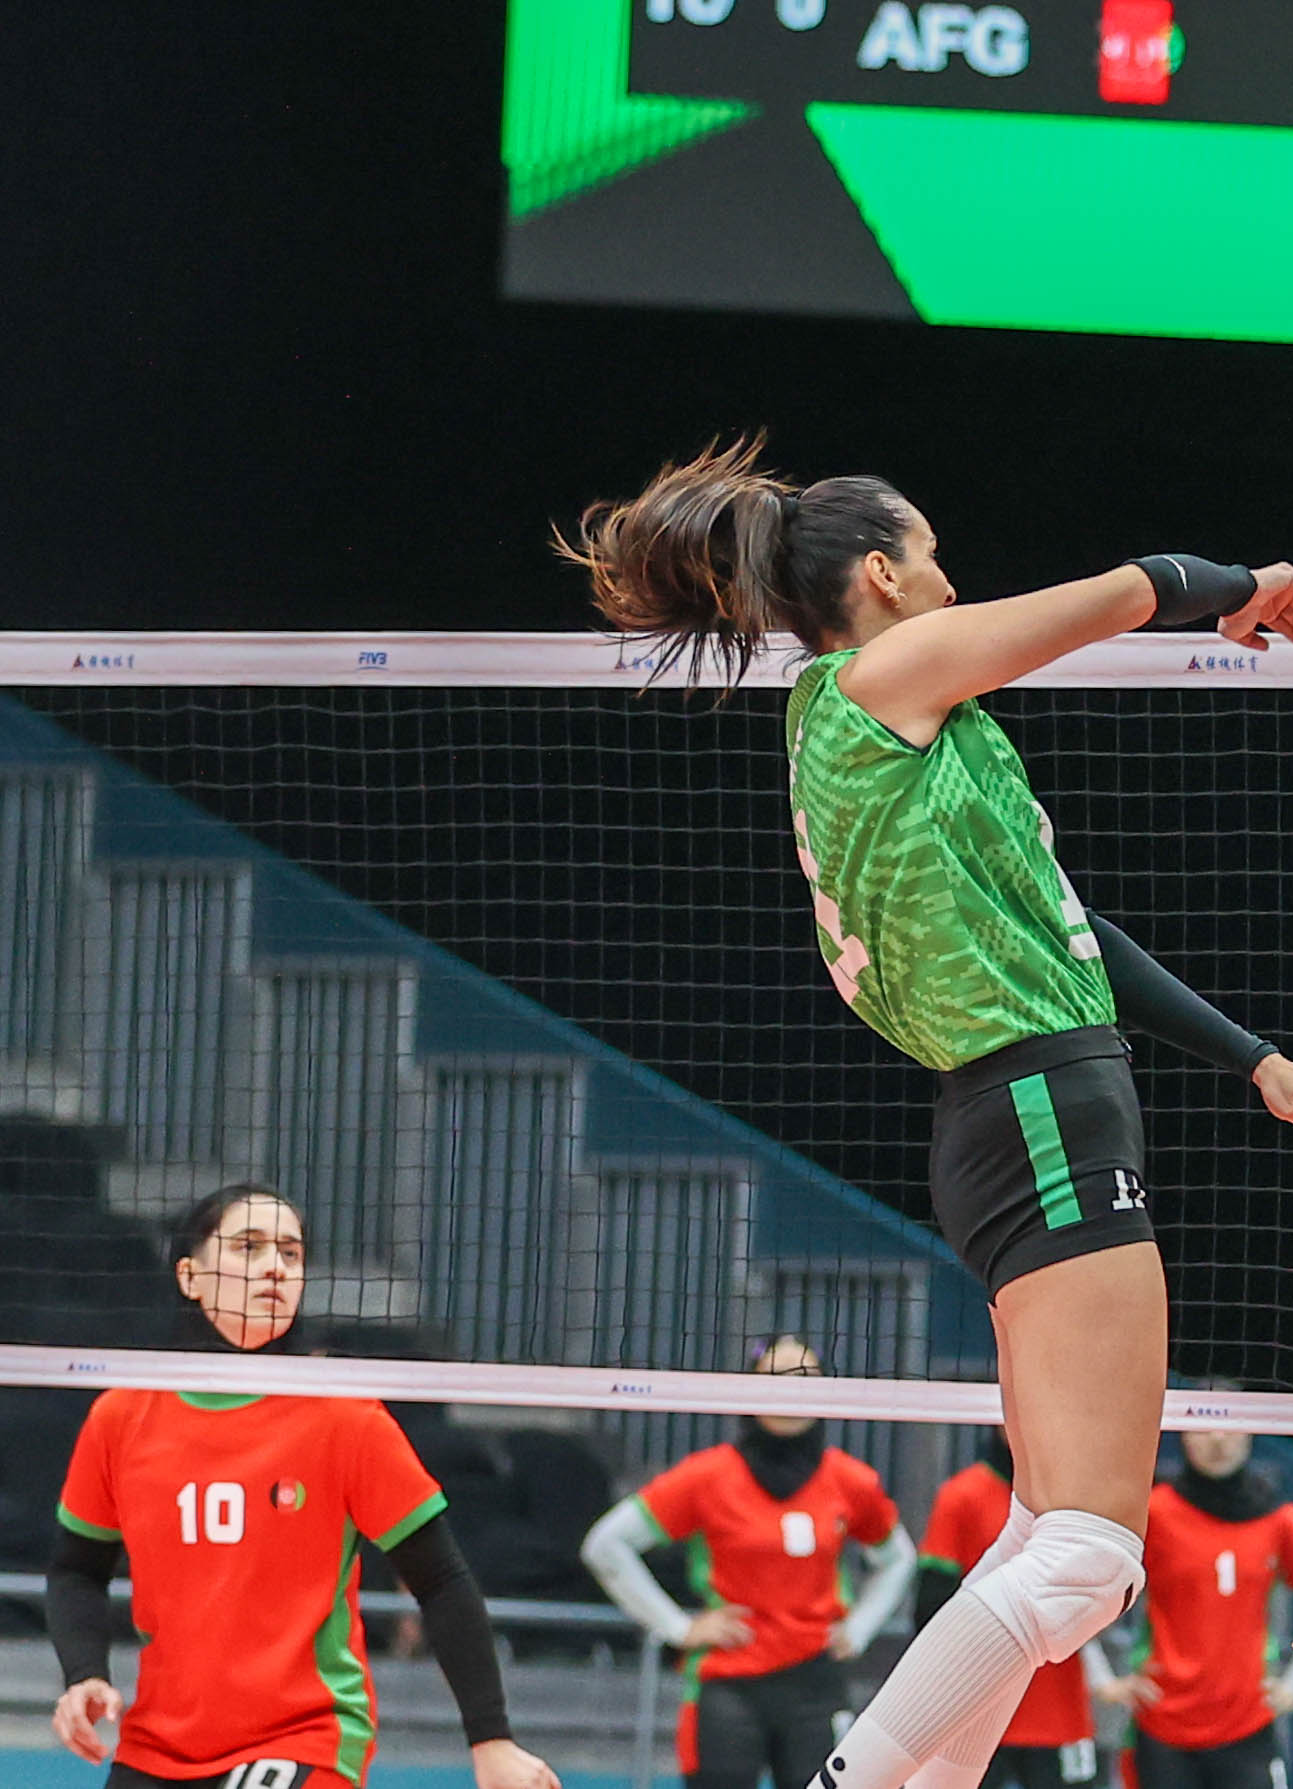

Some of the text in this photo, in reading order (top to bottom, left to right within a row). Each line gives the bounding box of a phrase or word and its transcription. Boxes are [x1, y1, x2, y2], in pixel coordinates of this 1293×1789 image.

[856, 2, 1029, 76] AFG
[177, 1482, 245, 1544] 10
[1215, 1550, 1236, 1597] 1
